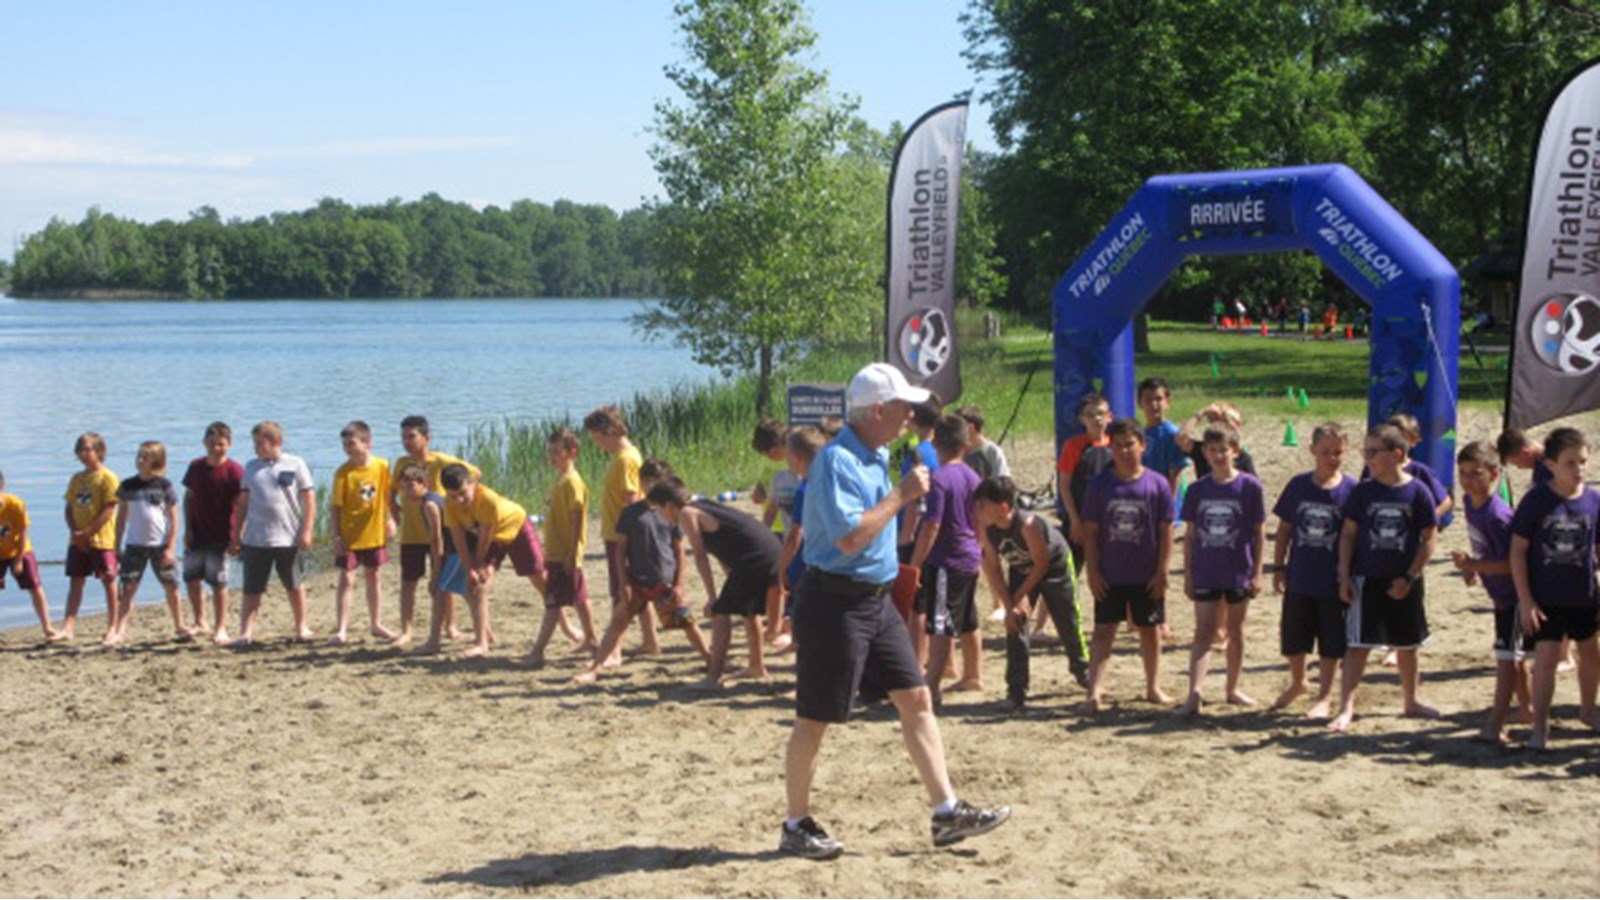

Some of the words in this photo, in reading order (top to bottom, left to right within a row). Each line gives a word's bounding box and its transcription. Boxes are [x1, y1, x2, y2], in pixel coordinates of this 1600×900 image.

[908, 168, 930, 299] Triathlon
[931, 167, 948, 293] VALLEYFIELD
[1068, 211, 1144, 298] TRIATHLON
[1190, 195, 1265, 225] ARRIVÉE
[1315, 197, 1403, 281] TRIATHLON
[1547, 126, 1593, 281] Triathlon
